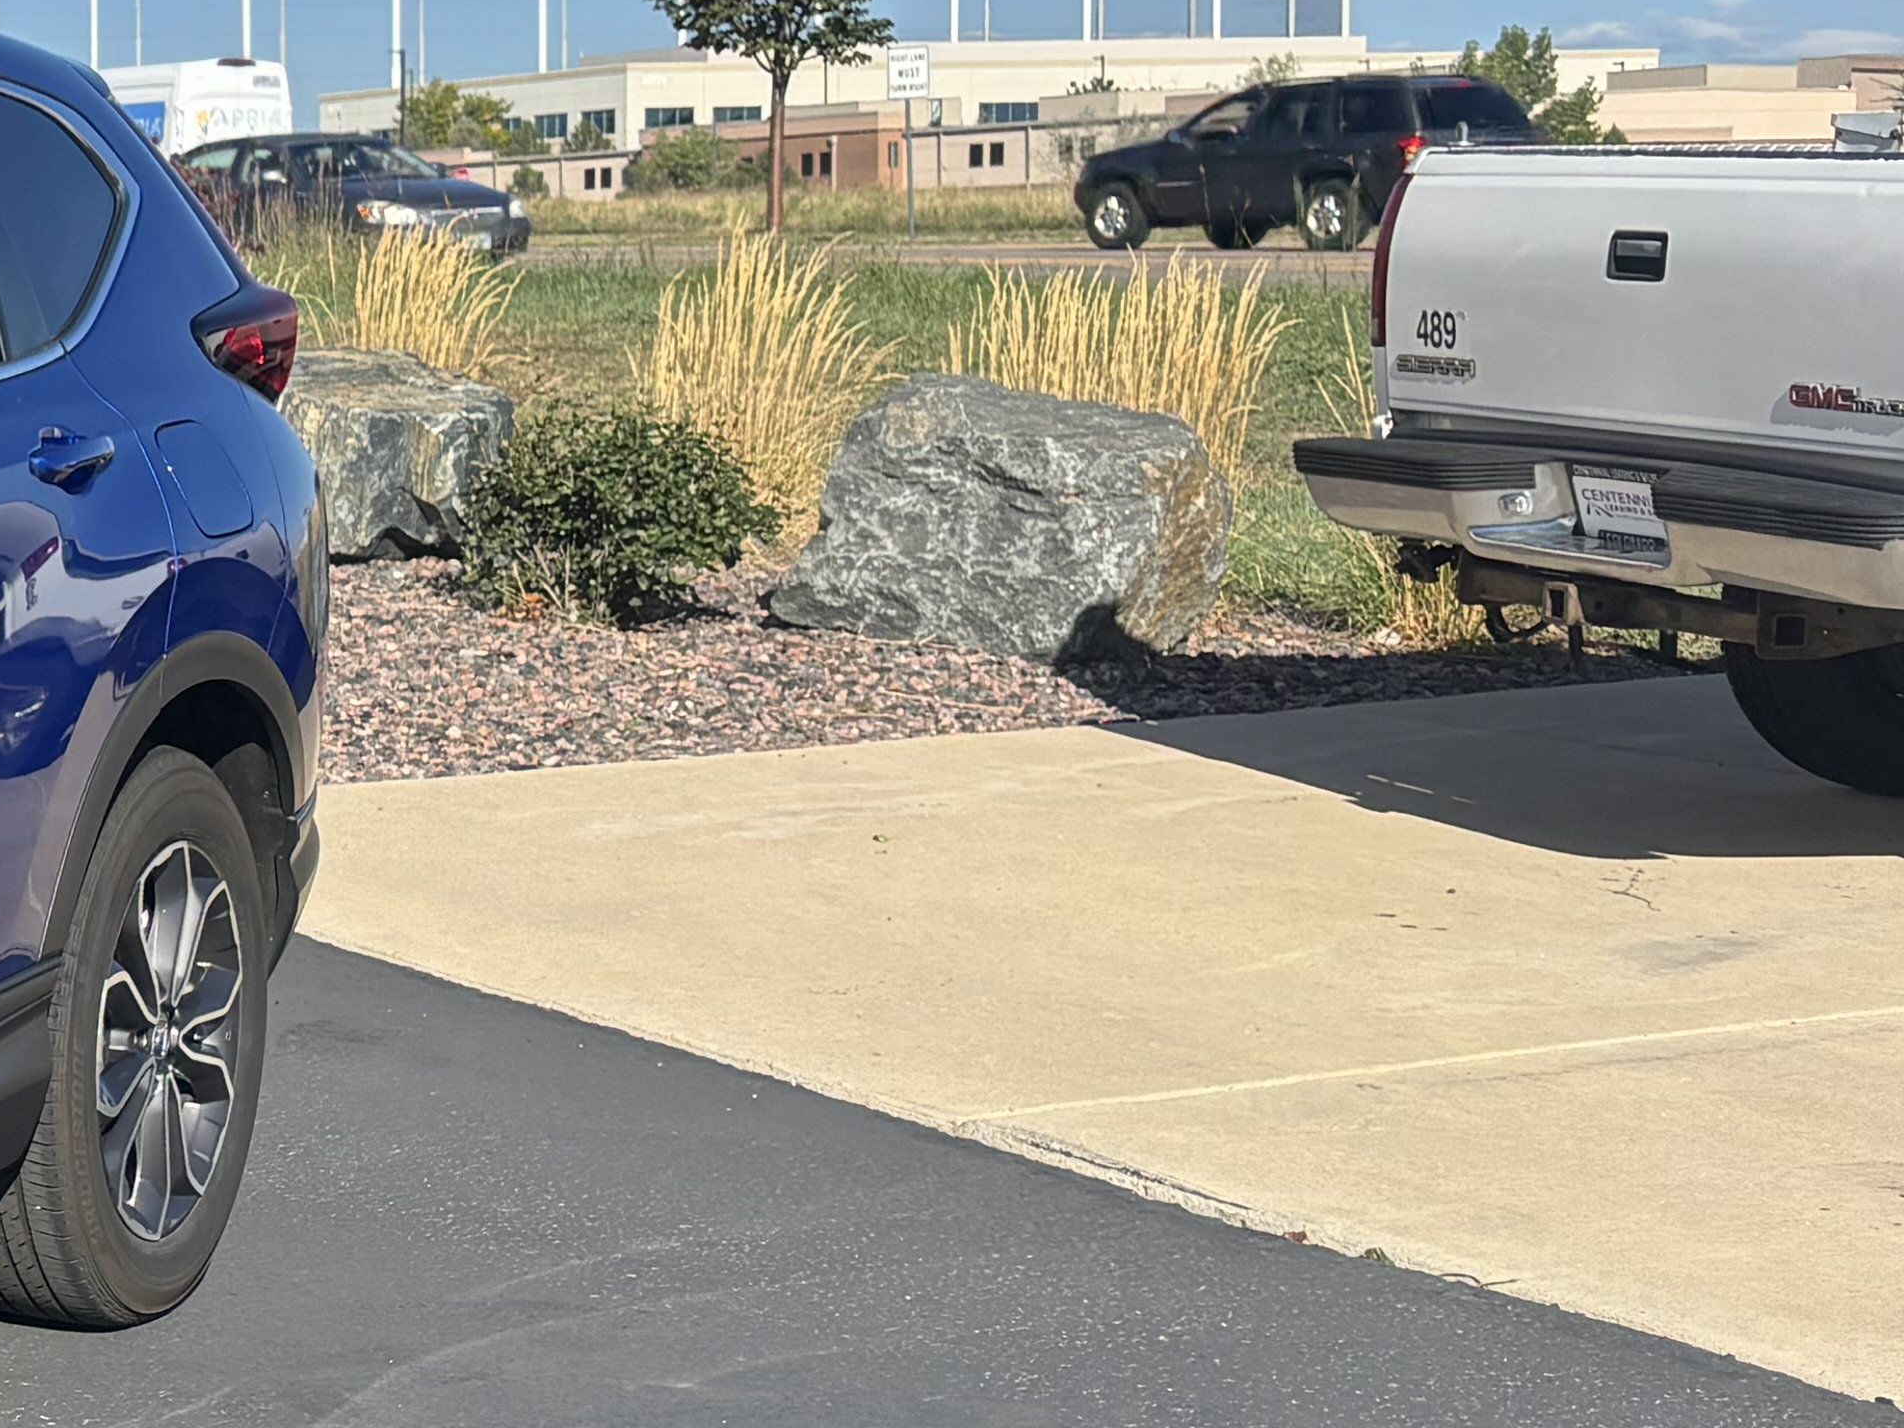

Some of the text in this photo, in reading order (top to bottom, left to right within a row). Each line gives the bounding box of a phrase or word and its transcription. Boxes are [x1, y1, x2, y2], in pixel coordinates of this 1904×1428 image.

[1416, 310, 1456, 349] 489
[1397, 354, 1475, 379] SIERRA
[1789, 383, 1855, 412] GMC
[1582, 488, 1653, 507] CENTENNI
